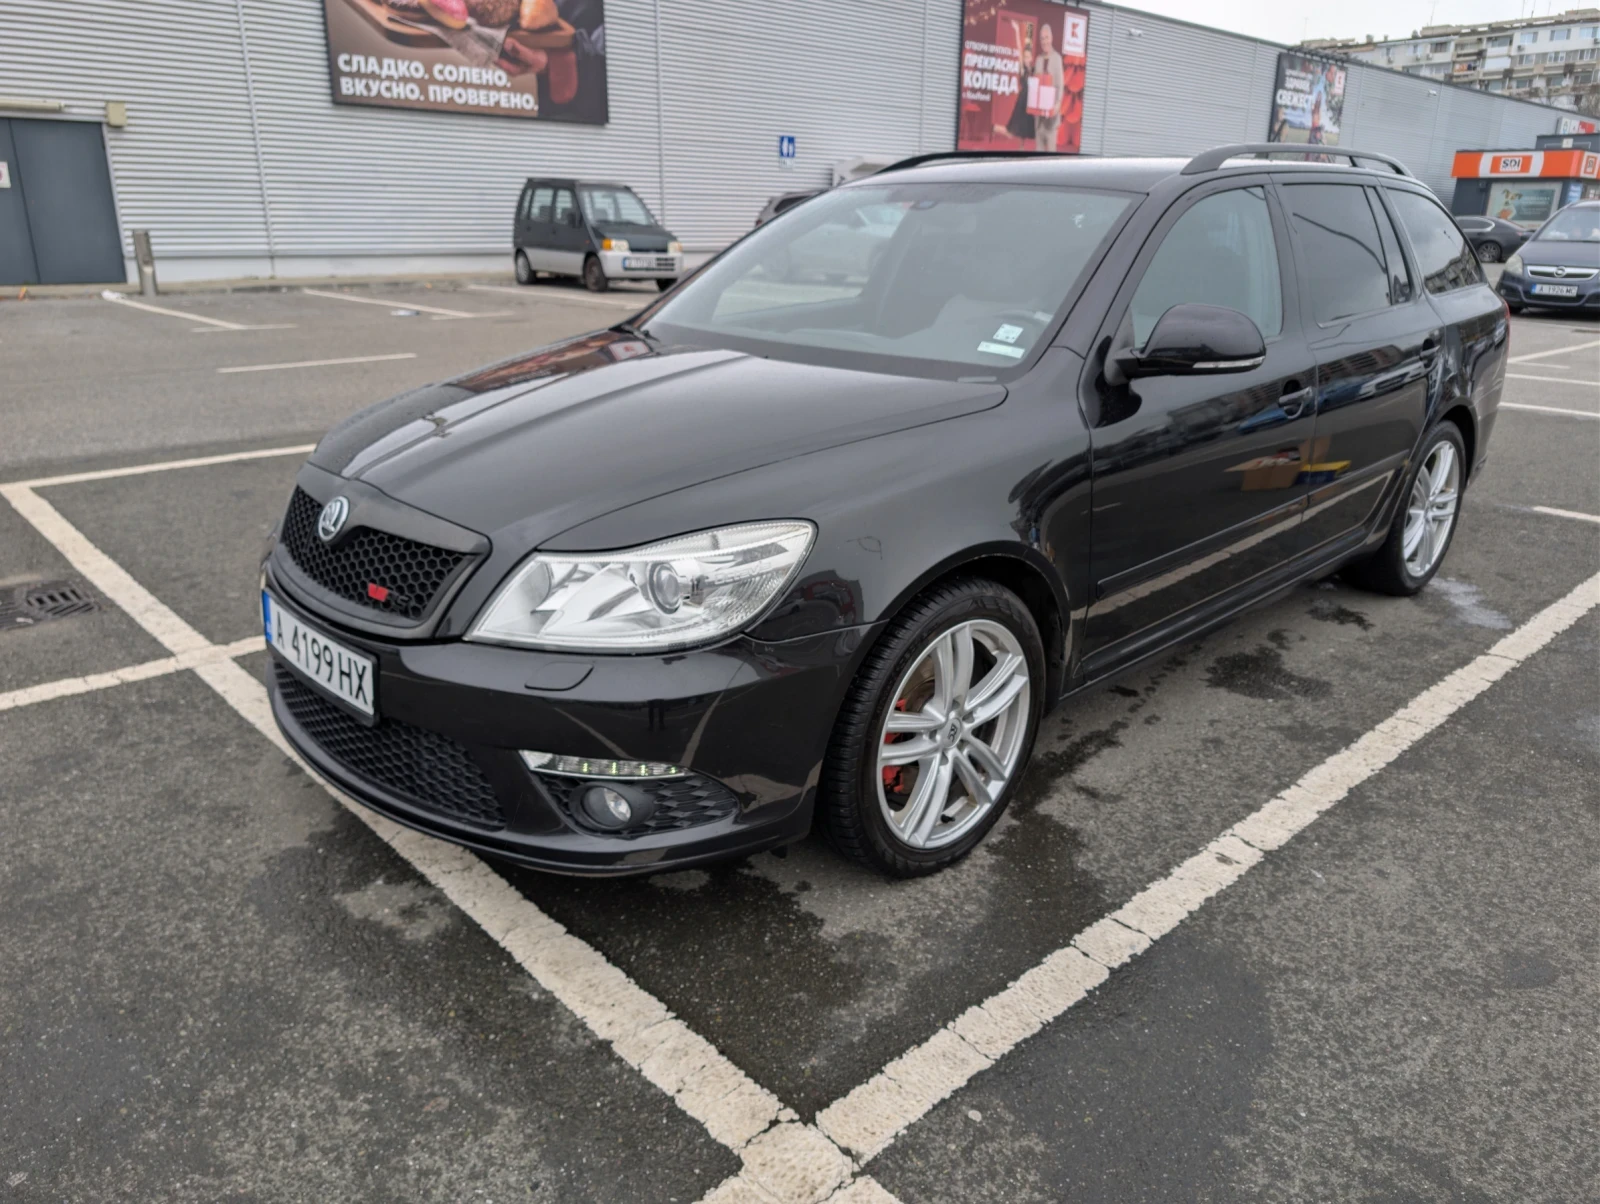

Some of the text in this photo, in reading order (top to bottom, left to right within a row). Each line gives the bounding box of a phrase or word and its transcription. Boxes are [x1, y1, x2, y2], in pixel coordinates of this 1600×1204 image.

[338, 53, 512, 88] СЛАДКО. СОЛЕНО.
[964, 53, 1020, 74] ПРЕКРАСНА
[339, 76, 539, 111] ВКУСНО. ПРОВЕРЕНО.
[963, 70, 1019, 95] КОЛЕДА
[276, 611, 285, 649] A
